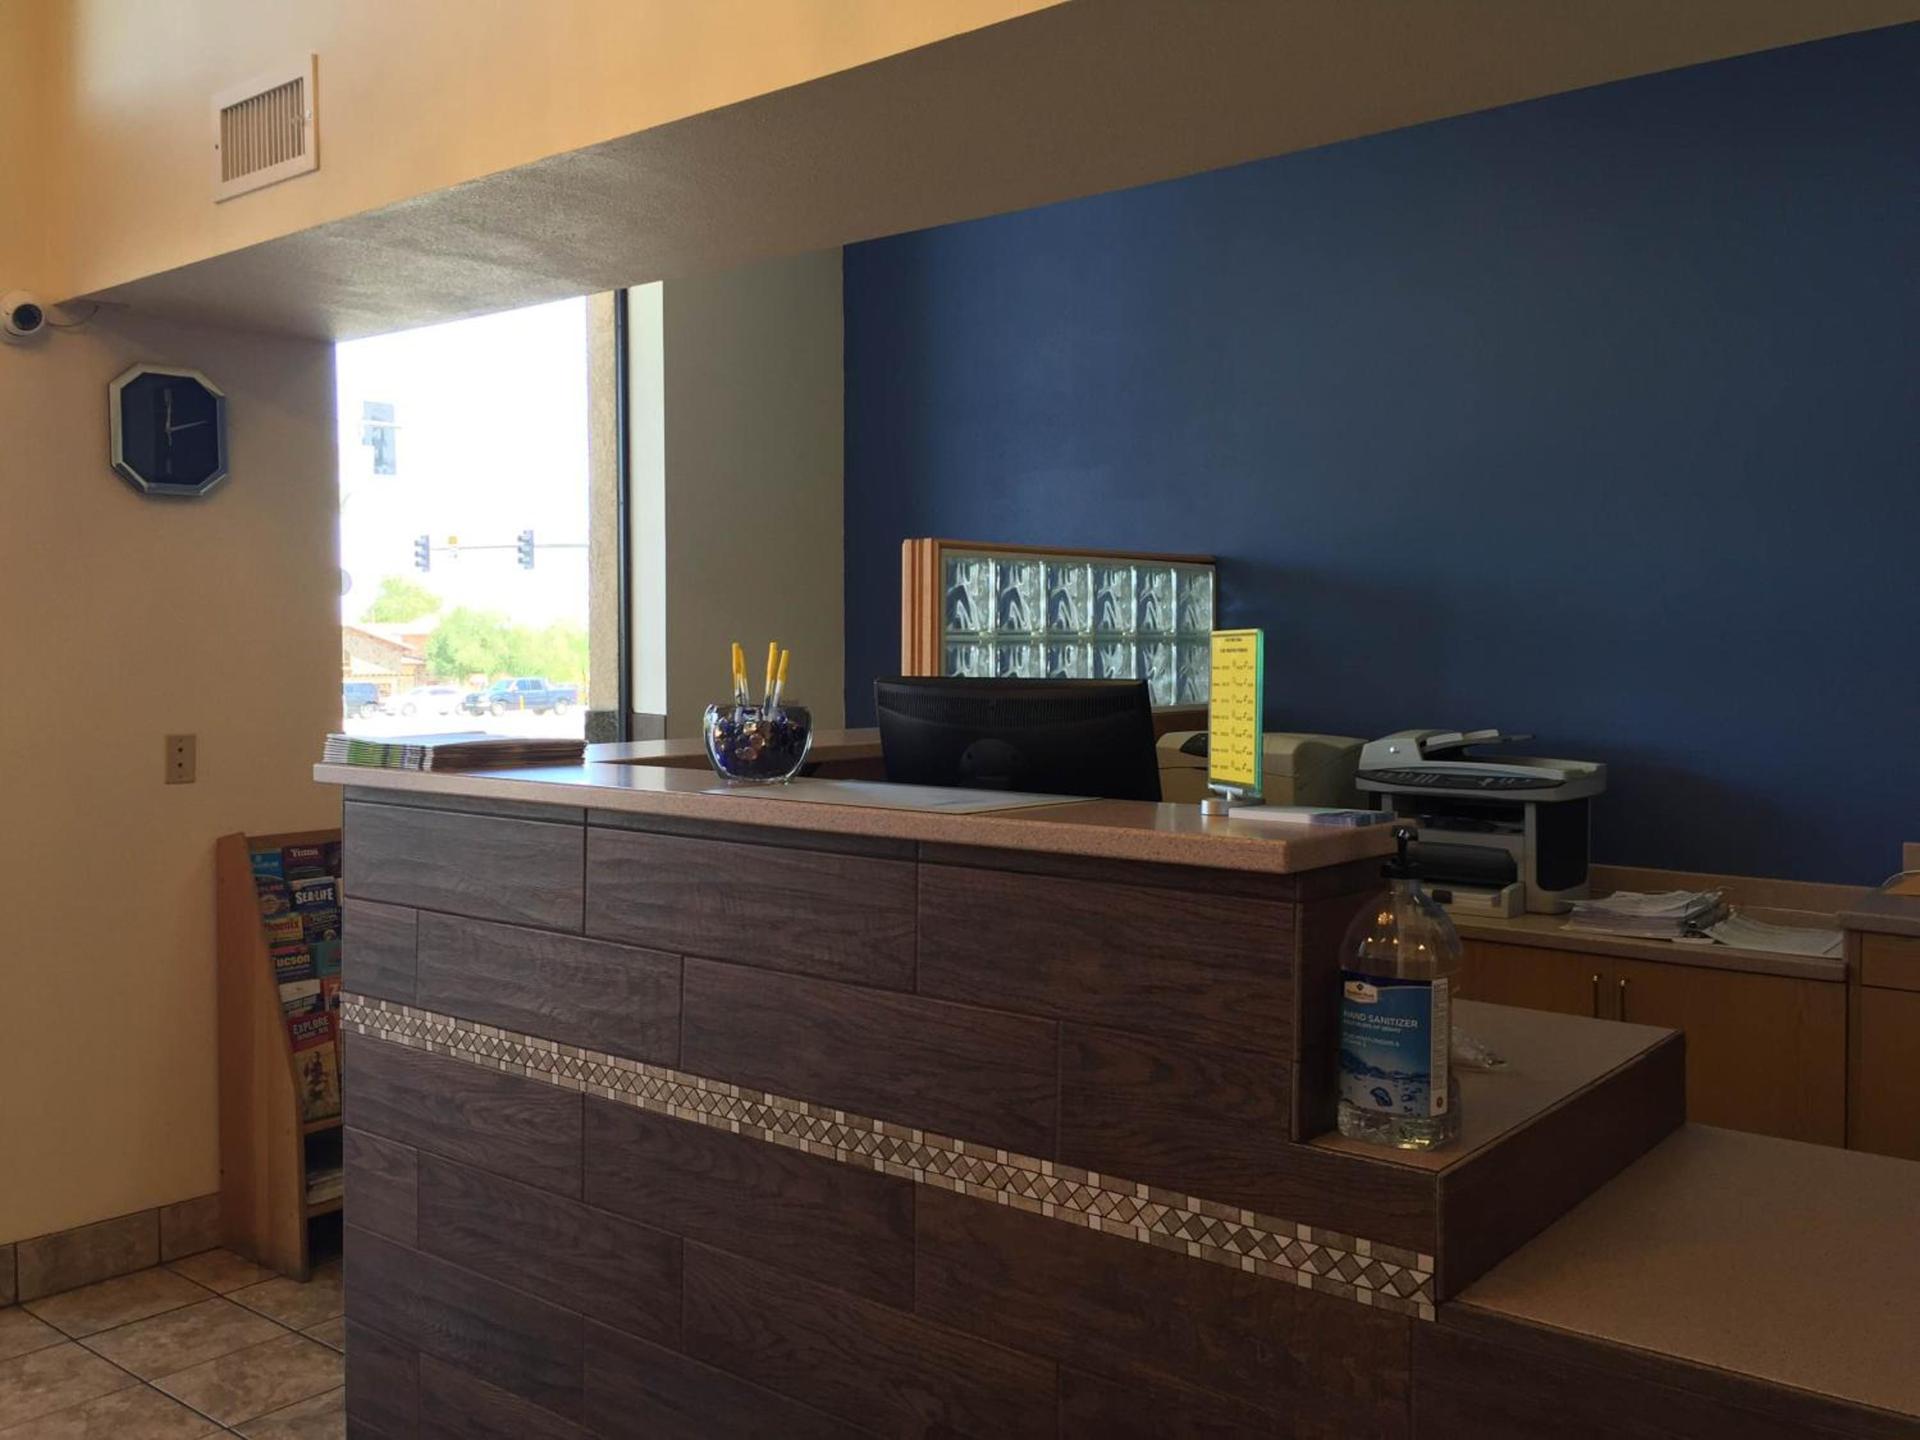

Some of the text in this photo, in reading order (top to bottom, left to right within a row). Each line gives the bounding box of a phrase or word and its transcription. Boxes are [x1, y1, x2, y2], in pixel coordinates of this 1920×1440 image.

[295, 887, 334, 905] SEA LIFE
[1368, 1014, 1418, 1029] SANITIZER
